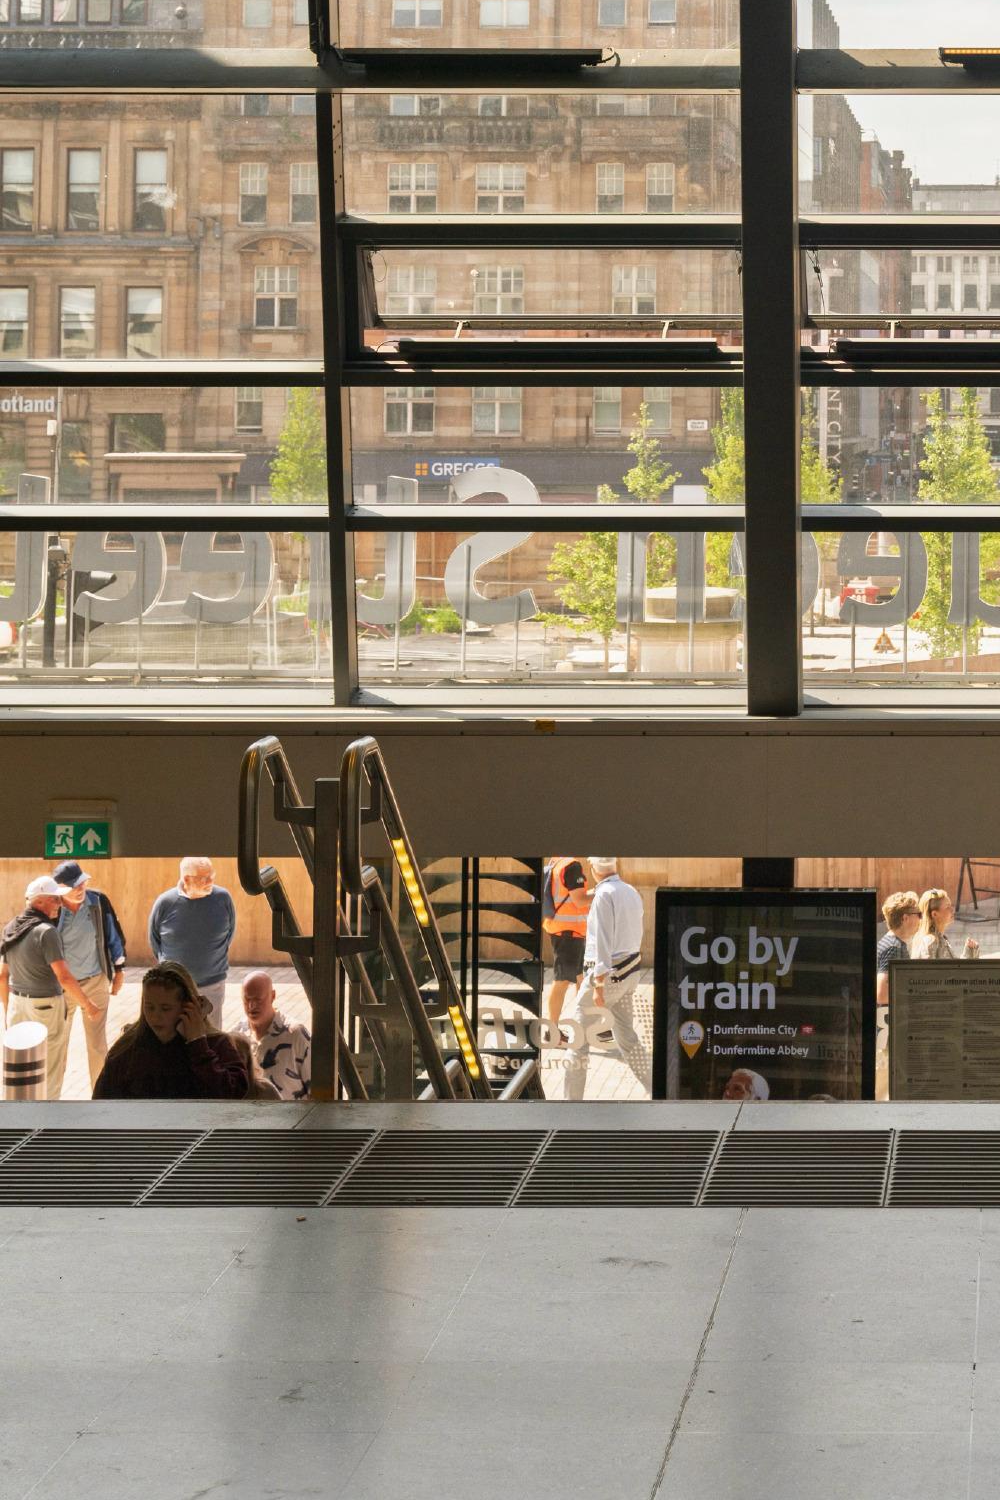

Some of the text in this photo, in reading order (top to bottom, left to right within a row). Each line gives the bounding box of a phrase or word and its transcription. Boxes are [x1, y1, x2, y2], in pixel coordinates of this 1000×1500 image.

[0, 395, 55, 413] otland
[827, 421, 842, 464] CITY
[679, 925, 799, 976] Go by
[678, 971, 776, 1010] train
[713, 1024, 798, 1037] Dunfermline City
[713, 1045, 776, 1056] Dunfermline
[776, 1045, 809, 1058] Abbey
